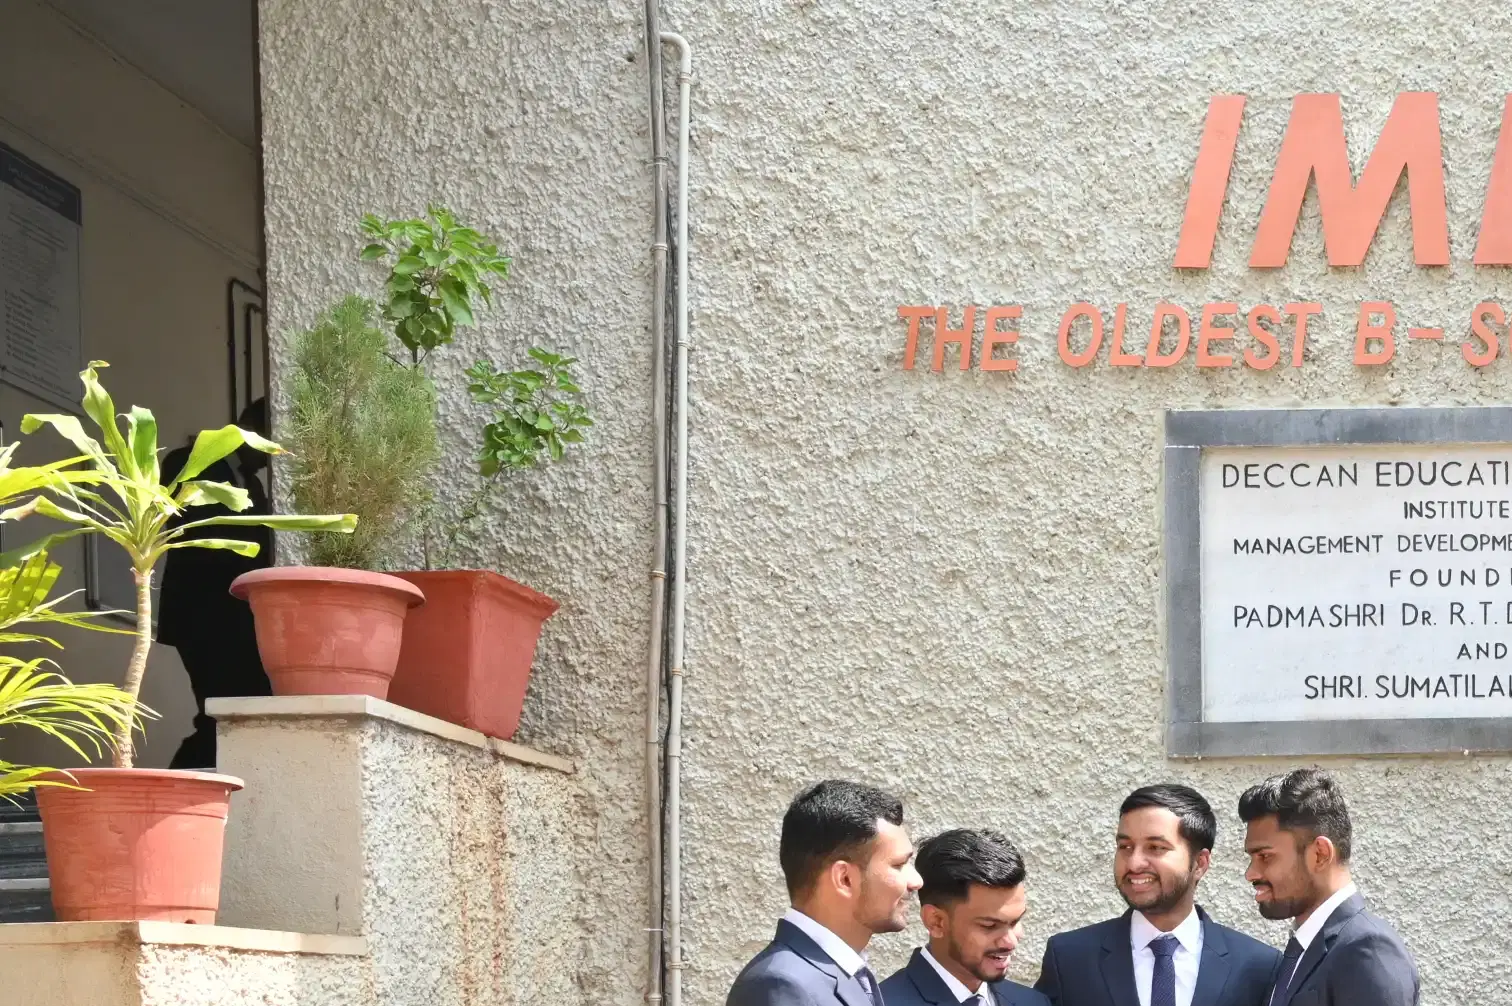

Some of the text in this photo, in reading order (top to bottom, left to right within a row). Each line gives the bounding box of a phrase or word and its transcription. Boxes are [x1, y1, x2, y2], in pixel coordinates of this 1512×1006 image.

[897, 305, 1022, 373] THE
[1058, 303, 1321, 370] OLDEST
[1222, 462, 1358, 489] DECCAN
[1403, 500, 1510, 520] INSTITUTE
[1233, 535, 1384, 555] MANAGEMENT
[1234, 603, 1384, 629] PADMASHRI
[1456, 642, 1508, 660] AND
[1304, 675, 1367, 700] SHRI.
